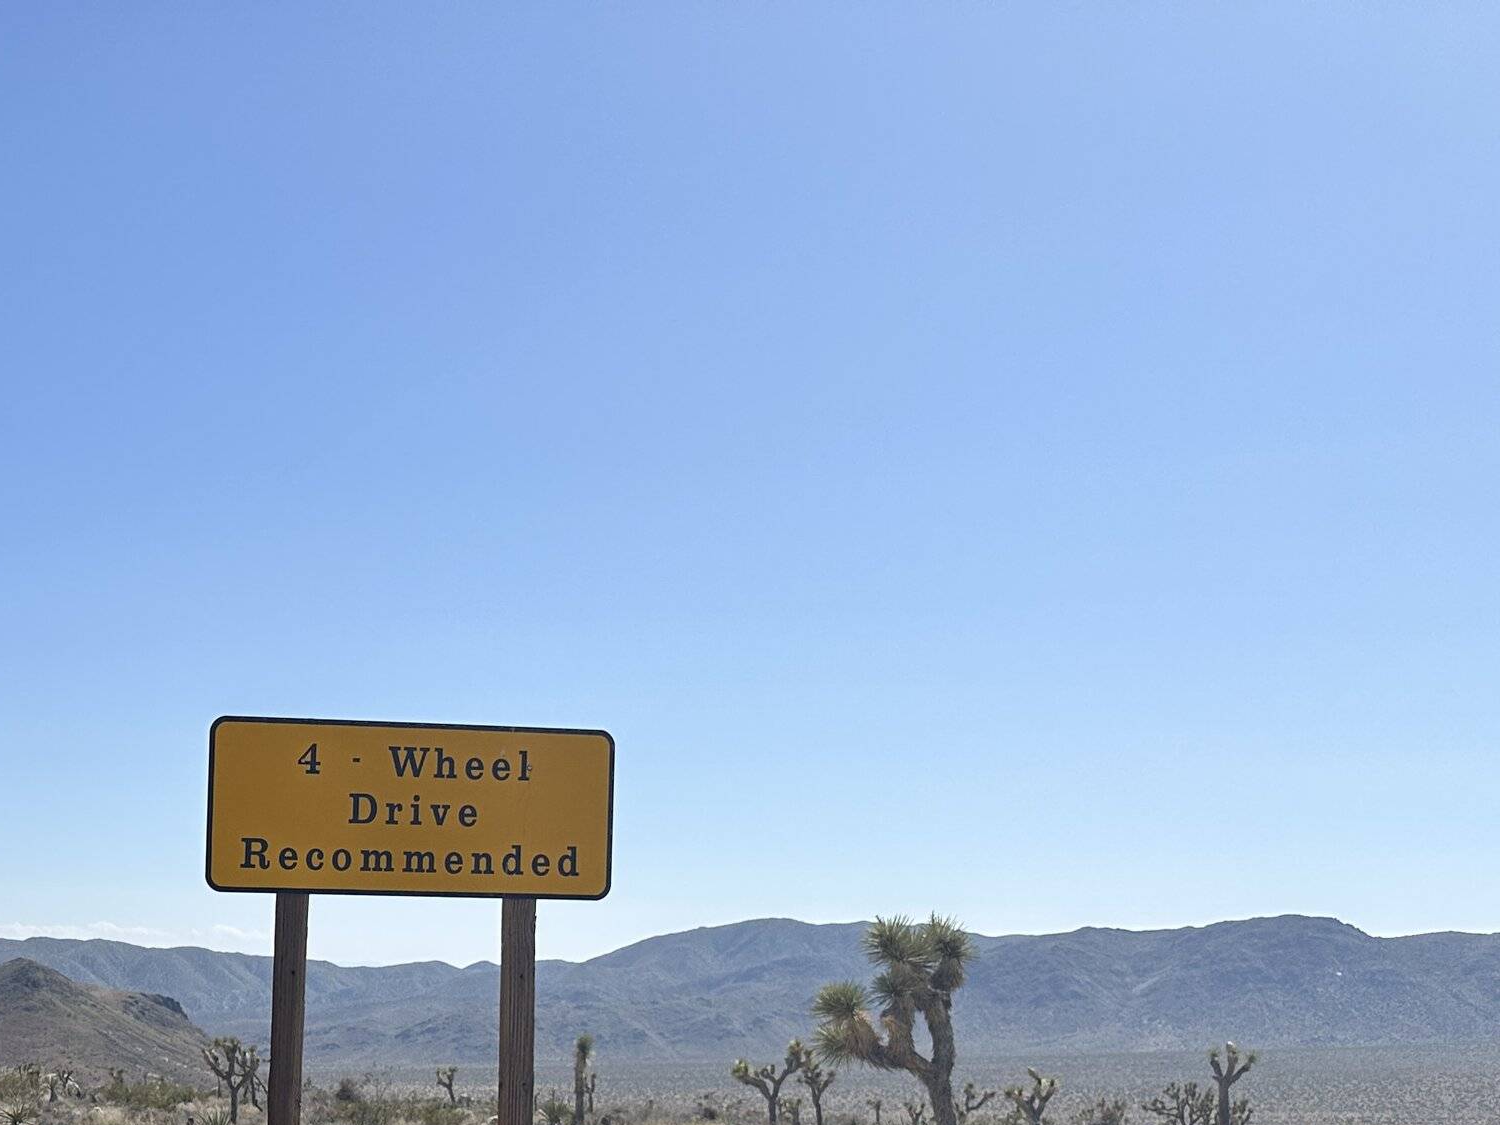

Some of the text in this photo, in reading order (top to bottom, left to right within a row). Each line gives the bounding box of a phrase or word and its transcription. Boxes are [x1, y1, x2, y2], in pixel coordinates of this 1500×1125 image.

[297, 743, 321, 775] 4
[388, 745, 533, 781] Wheel
[348, 792, 478, 828] Drive
[239, 837, 580, 877] Recommended
